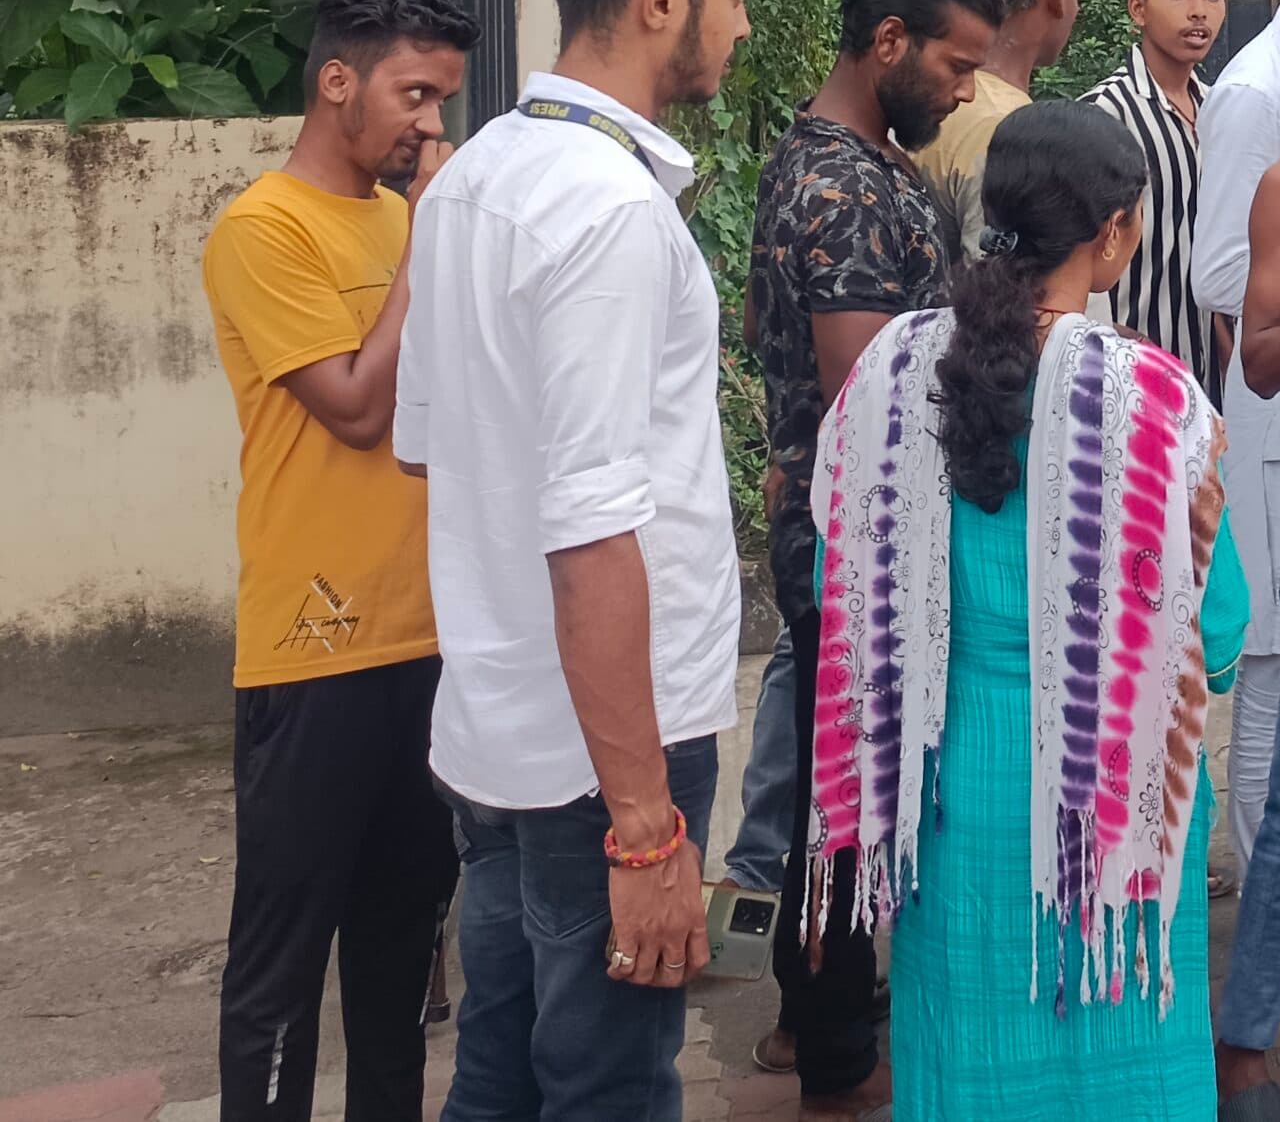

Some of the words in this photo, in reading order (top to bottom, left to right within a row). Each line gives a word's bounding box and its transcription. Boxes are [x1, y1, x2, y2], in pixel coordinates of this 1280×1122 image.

[529, 102, 571, 118] PRES
[588, 114, 637, 153] PRESS
[313, 573, 343, 610] FASHION
